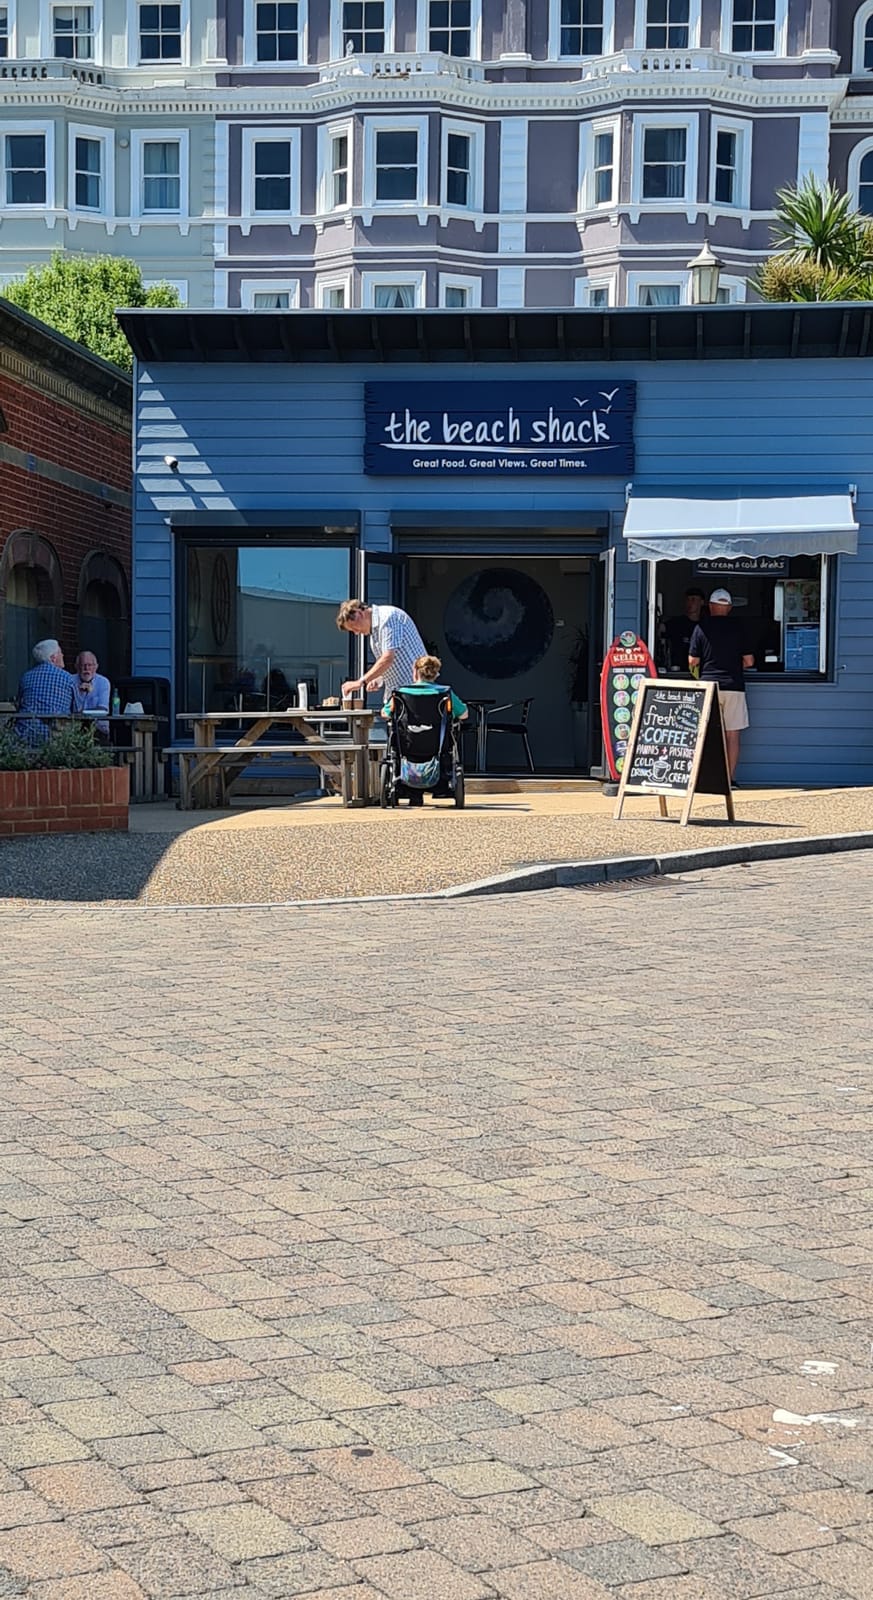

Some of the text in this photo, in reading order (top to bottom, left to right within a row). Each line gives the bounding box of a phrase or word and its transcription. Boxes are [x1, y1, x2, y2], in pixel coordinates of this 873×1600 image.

[384, 407, 610, 443] the beach shack
[412, 458, 588, 468] Great Food. Great Views. Great Times.
[741, 559, 758, 568] cold
[760, 557, 784, 568] drinks
[643, 705, 675, 726] fresh
[644, 727, 689, 747] COFFEE
[634, 757, 654, 767] COLD
[673, 760, 687, 771] ICE
[631, 767, 653, 777] DRINKS
